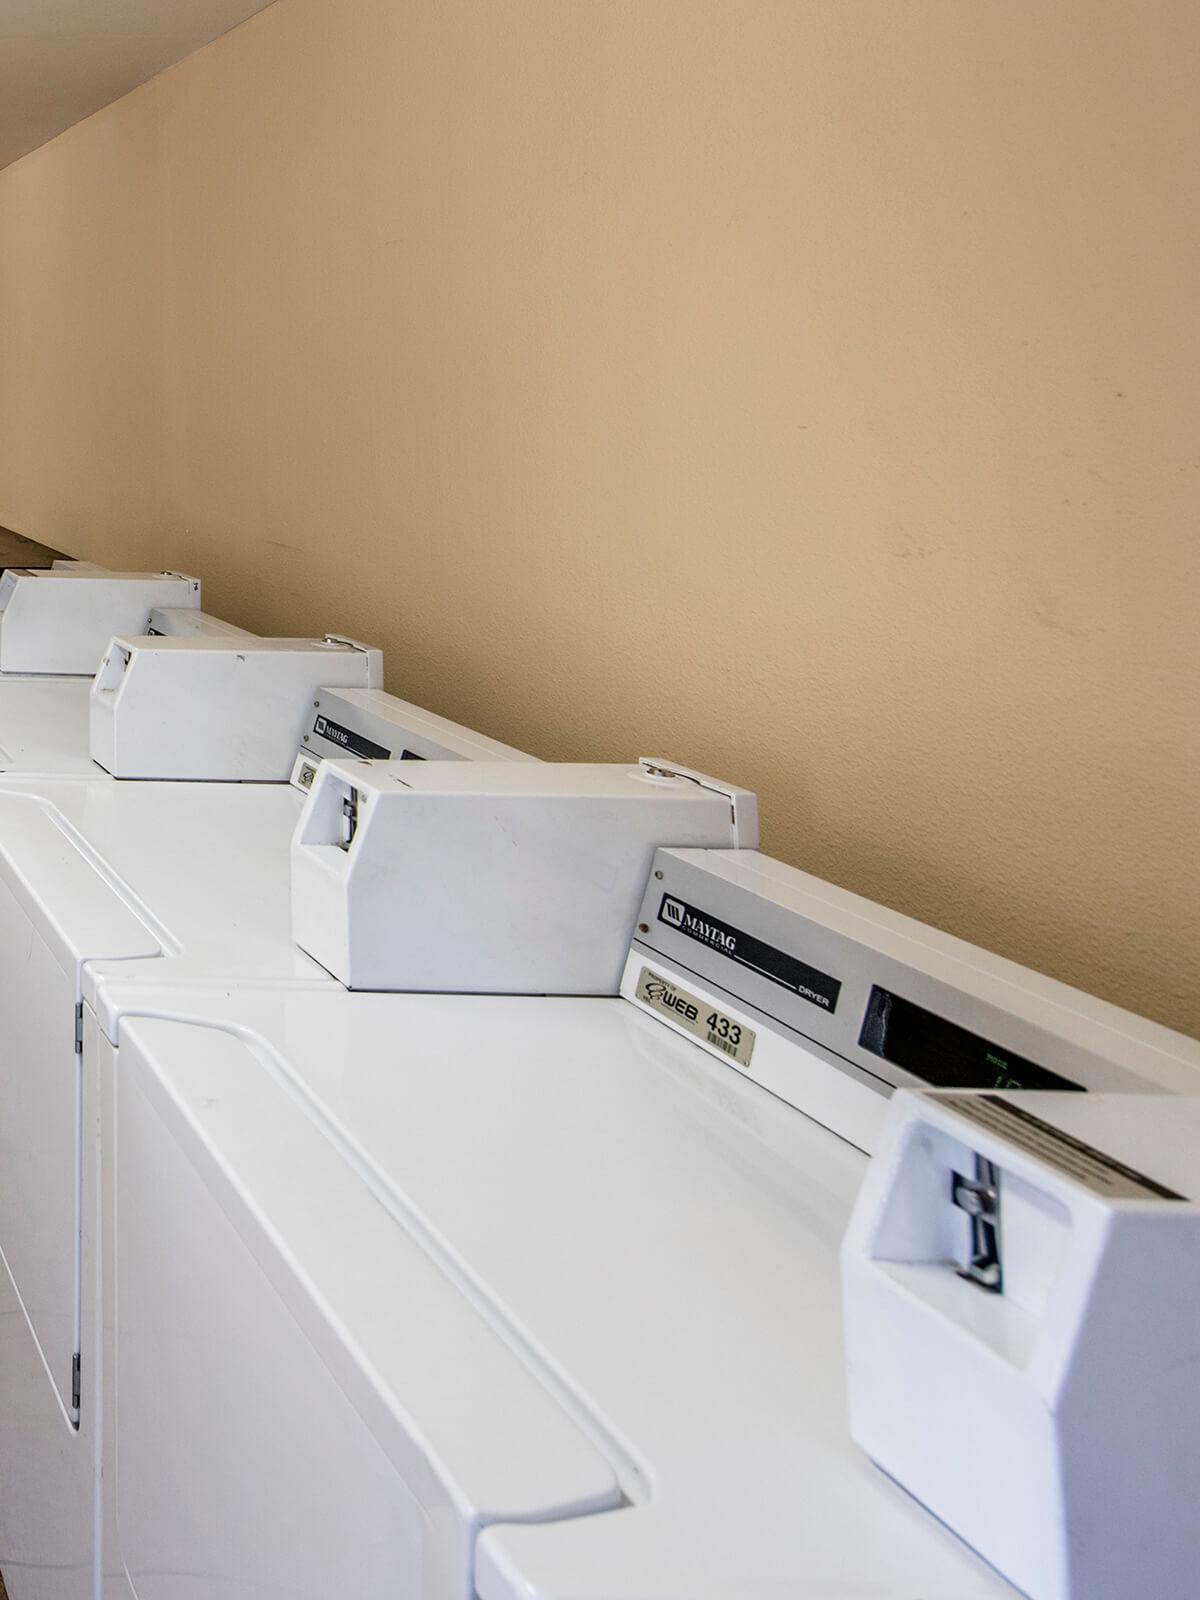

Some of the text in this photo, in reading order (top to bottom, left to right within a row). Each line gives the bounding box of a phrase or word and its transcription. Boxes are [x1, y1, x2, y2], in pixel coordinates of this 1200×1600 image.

[326, 725, 349, 744] MAYTAG
[682, 925, 734, 956] COMMERCIAL
[684, 913, 737, 950] MAYTAG
[798, 984, 830, 1008] DRYER
[663, 991, 699, 1021] WEB
[706, 1012, 742, 1045] 433
